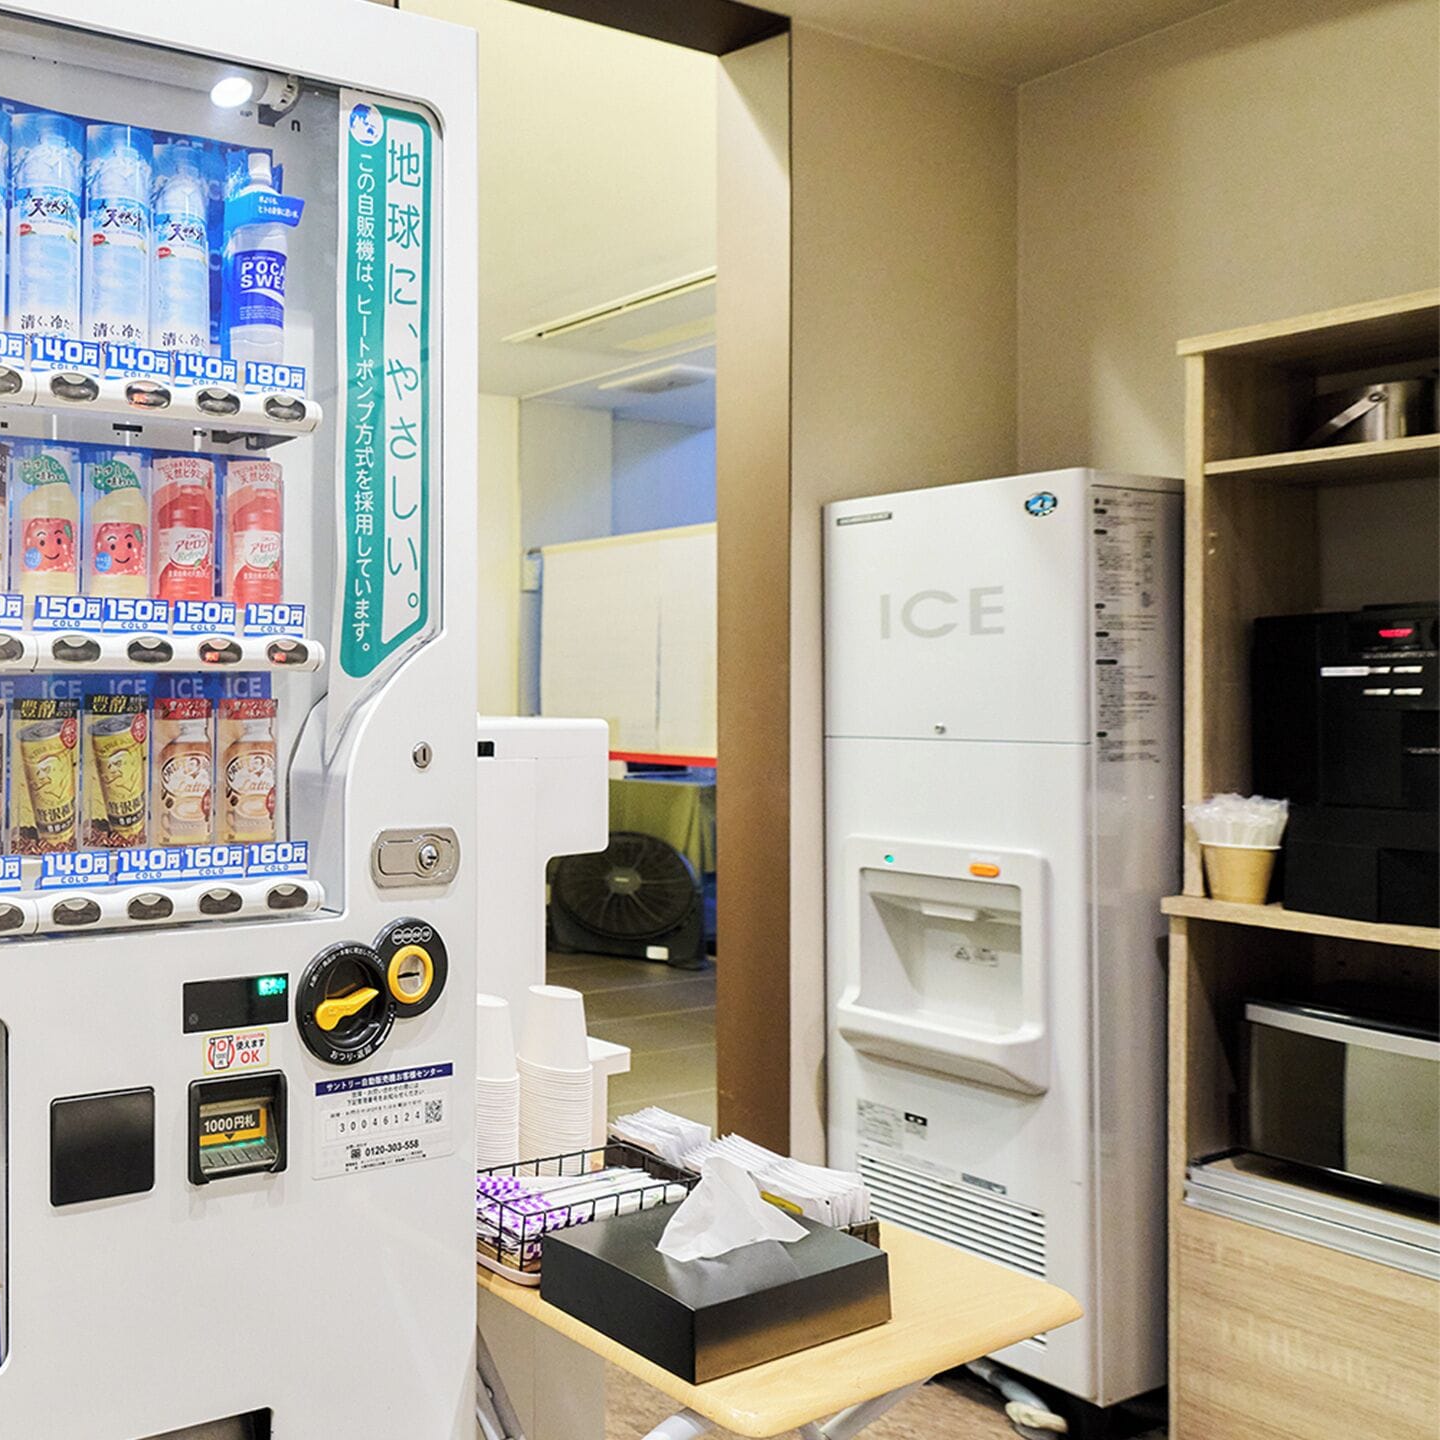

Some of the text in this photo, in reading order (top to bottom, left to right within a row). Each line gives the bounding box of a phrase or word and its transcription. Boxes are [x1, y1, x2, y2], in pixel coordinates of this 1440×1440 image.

[33, 337, 97, 366] 140円
[108, 345, 169, 374] 140円
[177, 353, 235, 381] 140円
[248, 363, 303, 388] 180円
[386, 139, 422, 608] 地球に、やさしい。
[352, 153, 376, 652] この自販機は、ヒートポンプ方式を採用しています。
[38, 597, 101, 619] 150円
[107, 600, 167, 622] 150円
[177, 602, 234, 623] 150円
[248, 604, 303, 625] 150円
[879, 585, 1005, 640] ICE
[121, 622, 148, 630] COLD
[190, 623, 216, 631] COLD
[260, 625, 286, 633] COLD
[41, 680, 82, 699] ICE
[170, 678, 205, 698] ICE
[226, 677, 262, 698] ICE
[120, 849, 180, 872] 140円
[185, 847, 242, 868] 160円
[253, 842, 306, 864] 160円
[44, 853, 108, 875] 140円
[198, 867, 224, 875] COLD
[264, 864, 289, 872] COLD
[61, 875, 89, 883] COLD
[135, 871, 162, 879] COLD
[236, 1039, 265, 1051] 使えます
[241, 1049, 260, 1063] OK
[326, 1068, 443, 1092] サントリー自動販売機お客様センター
[204, 1114, 256, 1133] 1000円札
[365, 1139, 419, 1157] 0120-303-558
